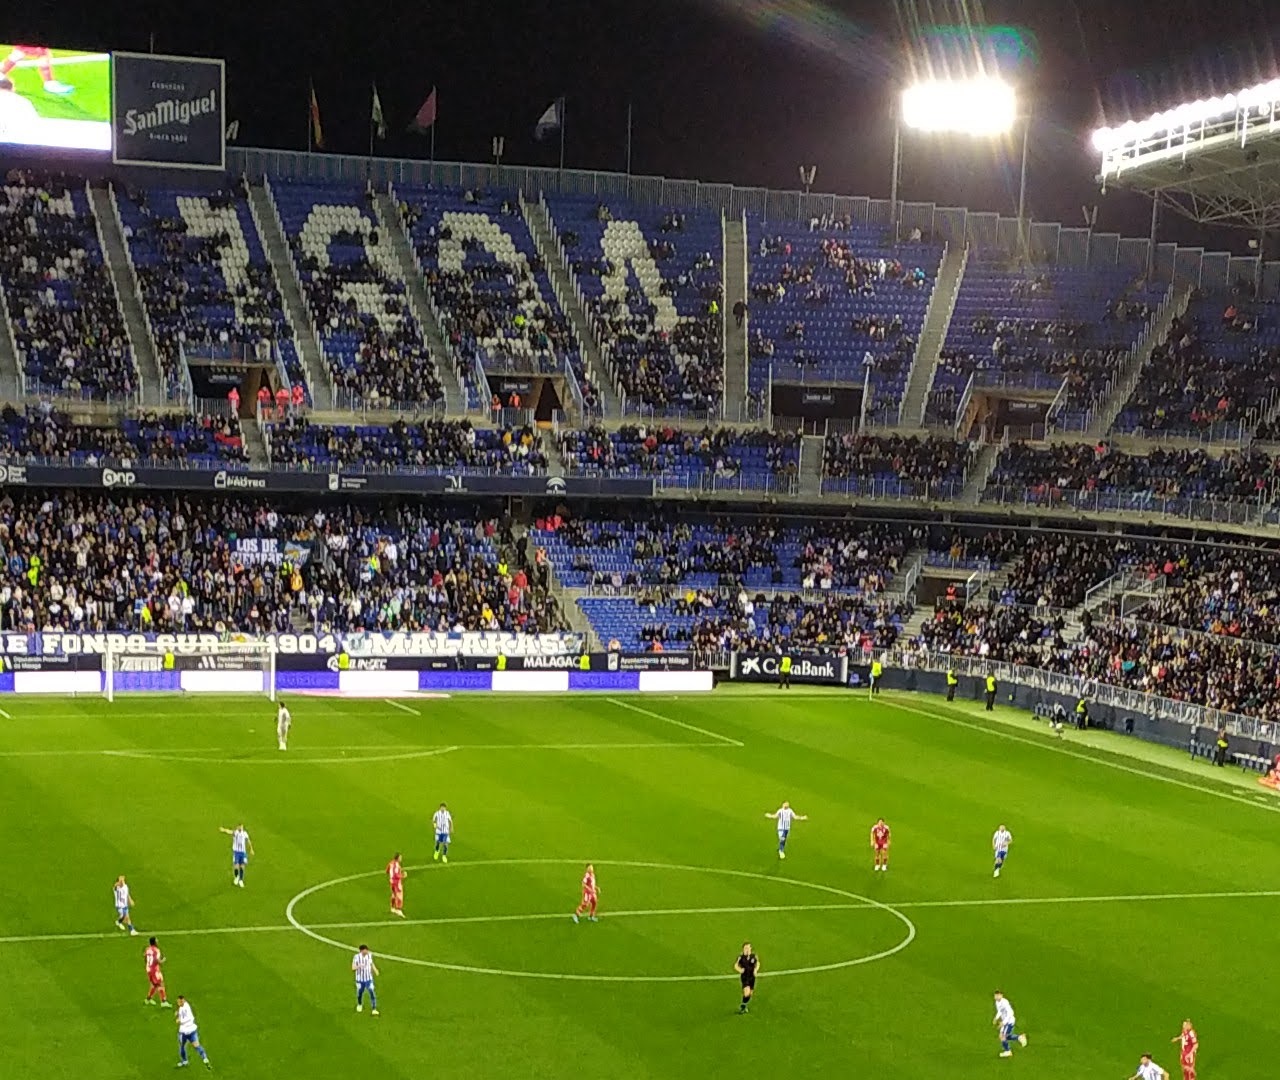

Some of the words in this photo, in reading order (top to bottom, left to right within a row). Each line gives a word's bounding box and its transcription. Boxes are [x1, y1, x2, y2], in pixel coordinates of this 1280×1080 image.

[236, 538, 258, 553] LOS
[261, 538, 278, 553] DE
[42, 634, 146, 653] FONDO
[266, 634, 337, 654] 1904
[370, 633, 560, 655] MALAKAS
[762, 659, 835, 678] CaxaBank
